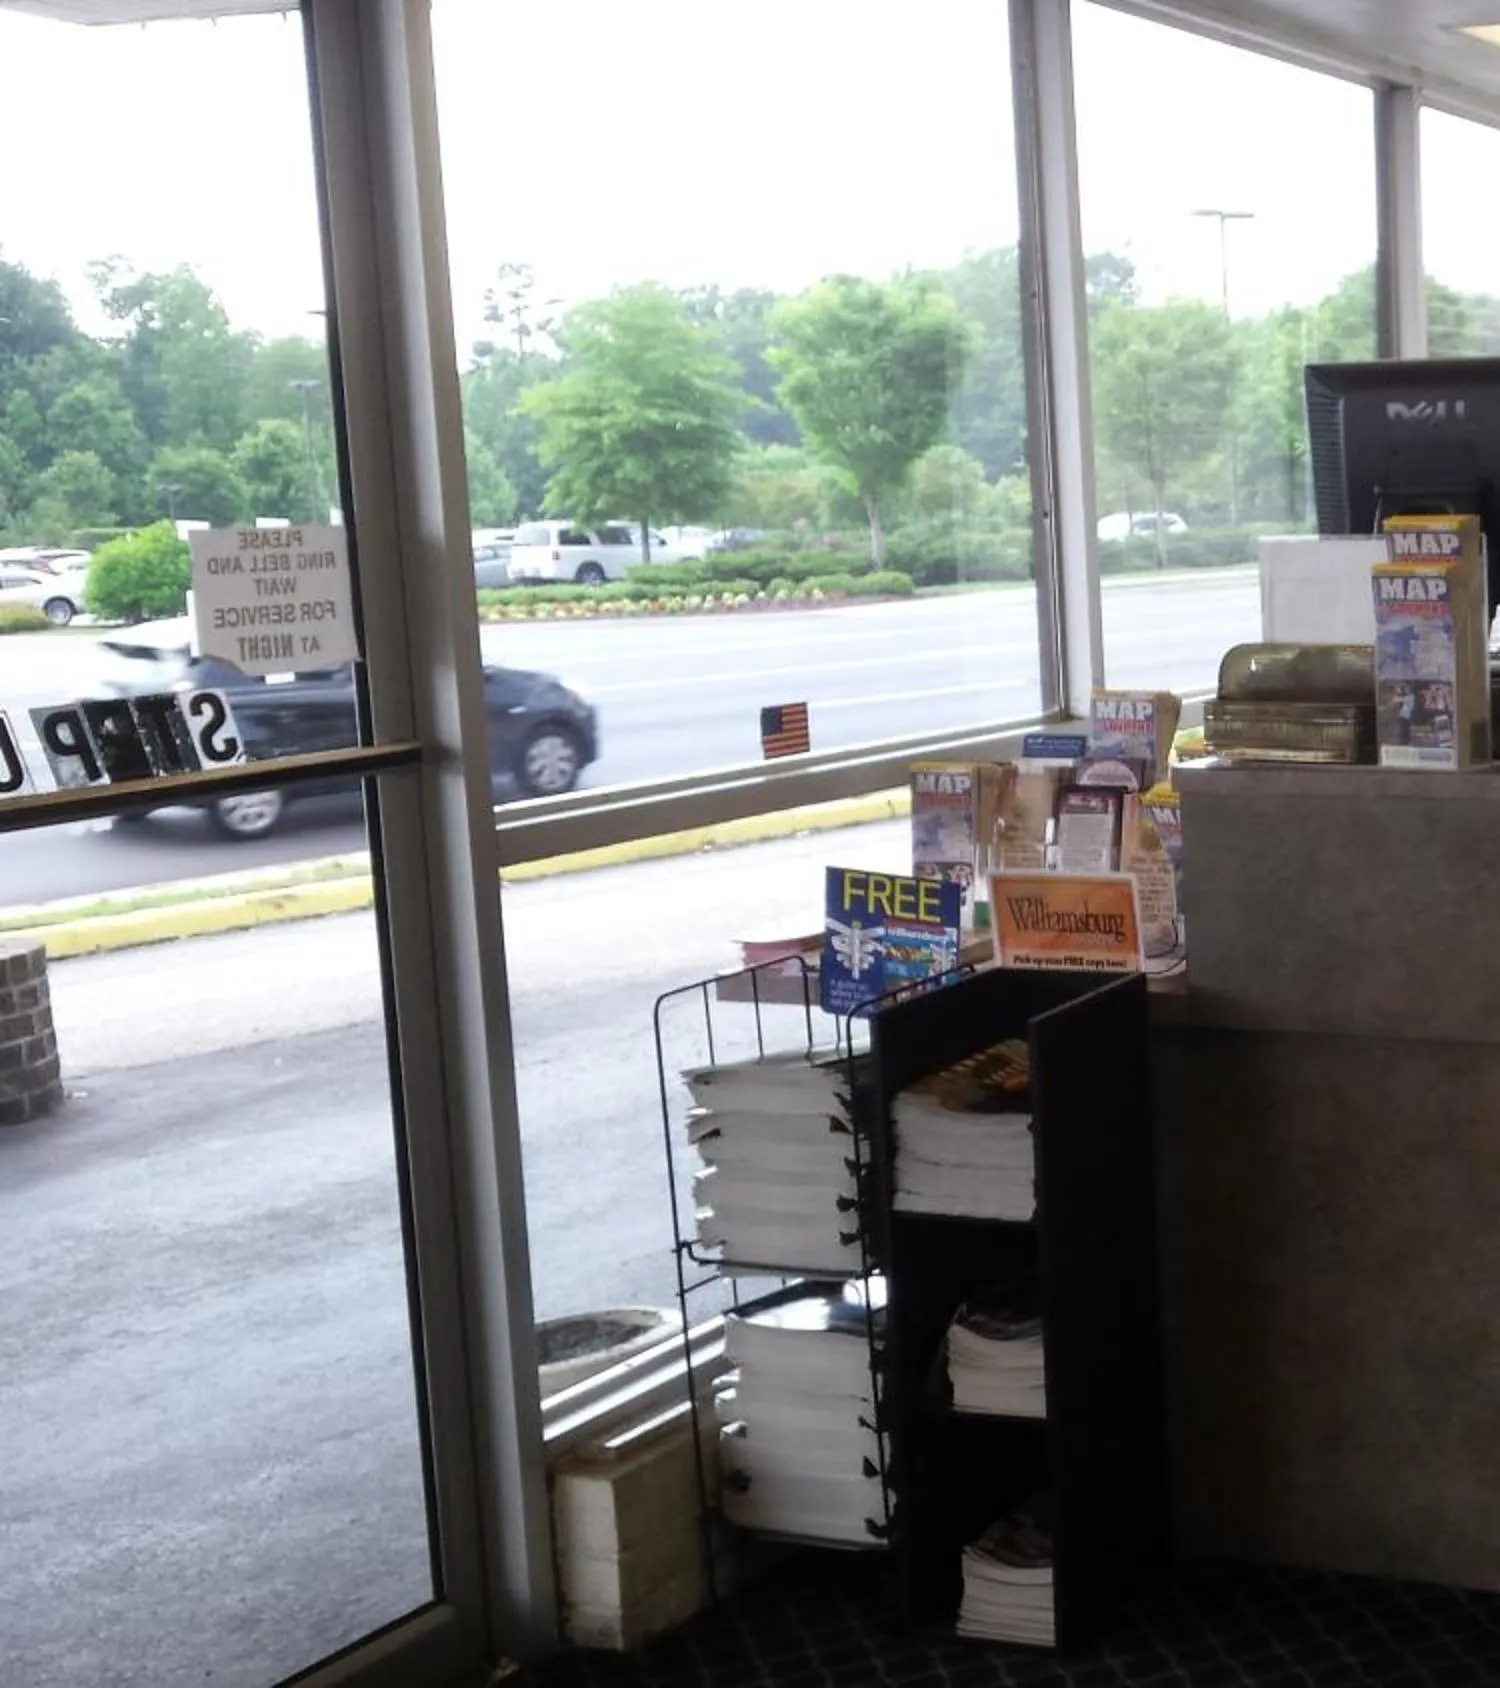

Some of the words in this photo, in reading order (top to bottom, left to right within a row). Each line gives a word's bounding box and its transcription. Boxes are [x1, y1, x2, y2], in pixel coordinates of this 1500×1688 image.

[1392, 532, 1460, 555] MAP
[1379, 577, 1448, 601] MAP
[1096, 701, 1153, 720] MAP
[915, 773, 970, 794] MAP
[843, 869, 942, 923] FREE
[1006, 894, 1127, 944] Williamsburg
